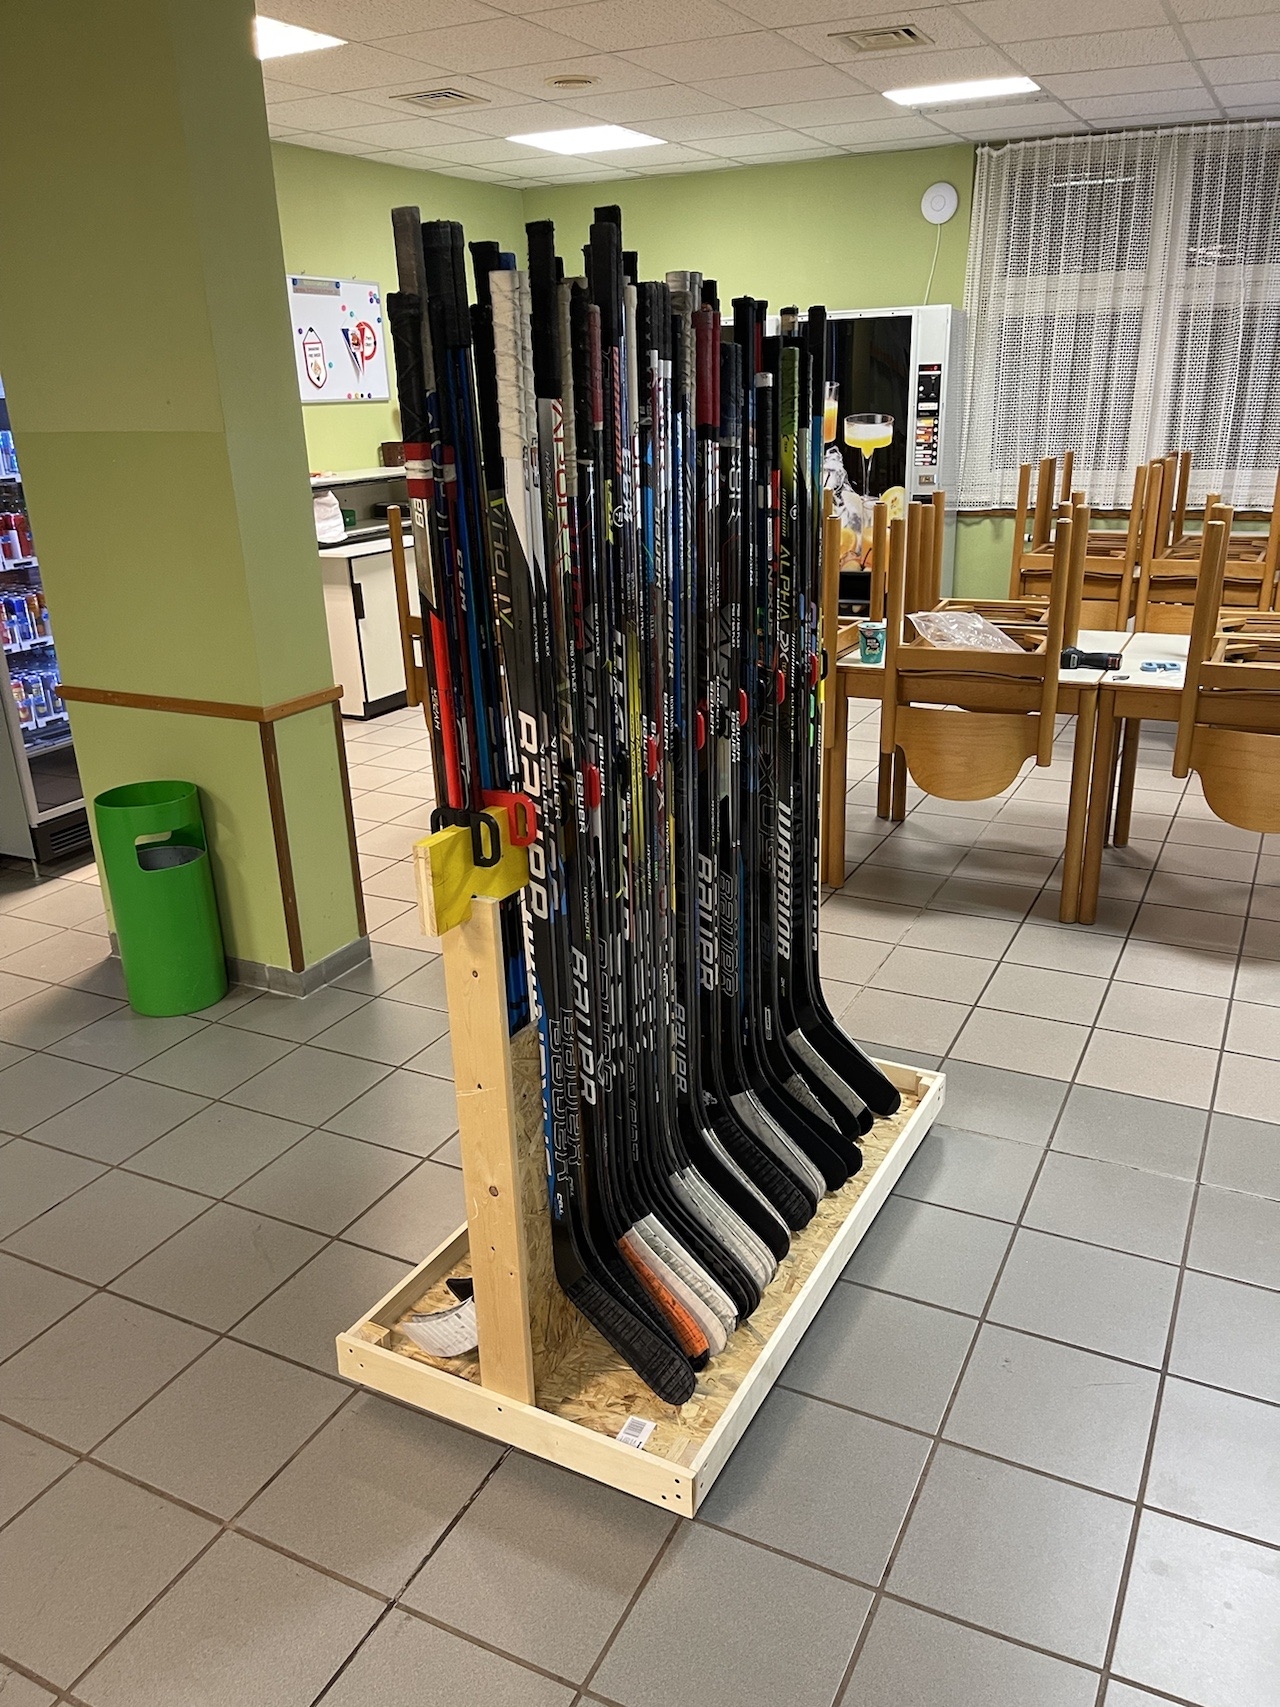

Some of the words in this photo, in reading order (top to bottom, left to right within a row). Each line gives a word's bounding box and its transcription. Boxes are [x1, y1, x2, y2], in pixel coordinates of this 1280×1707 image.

[545, 450, 555, 522] HYPERLITE
[622, 447, 633, 523] CCM
[456, 548, 468, 613] CCM
[488, 496, 514, 630] ALPHA
[654, 506, 662, 588] BAUER
[779, 544, 791, 621] ALPHA
[779, 629, 790, 664] DX
[538, 757, 551, 827] BAUER
[550, 751, 562, 821] BAUER
[575, 771, 587, 833] BAUER
[598, 734, 606, 797] BAUER
[757, 668, 776, 873] NEXUS
[583, 887, 591, 942] HYPERLITE
[777, 800, 792, 961] WARRIOR
[697, 852, 714, 991] BAUER
[720, 870, 735, 998] BAUER
[570, 945, 597, 1106] BAUER
[675, 1002, 688, 1094] BAUER
[548, 1018, 569, 1182] BAUER
[558, 1007, 583, 1166] BAUER
